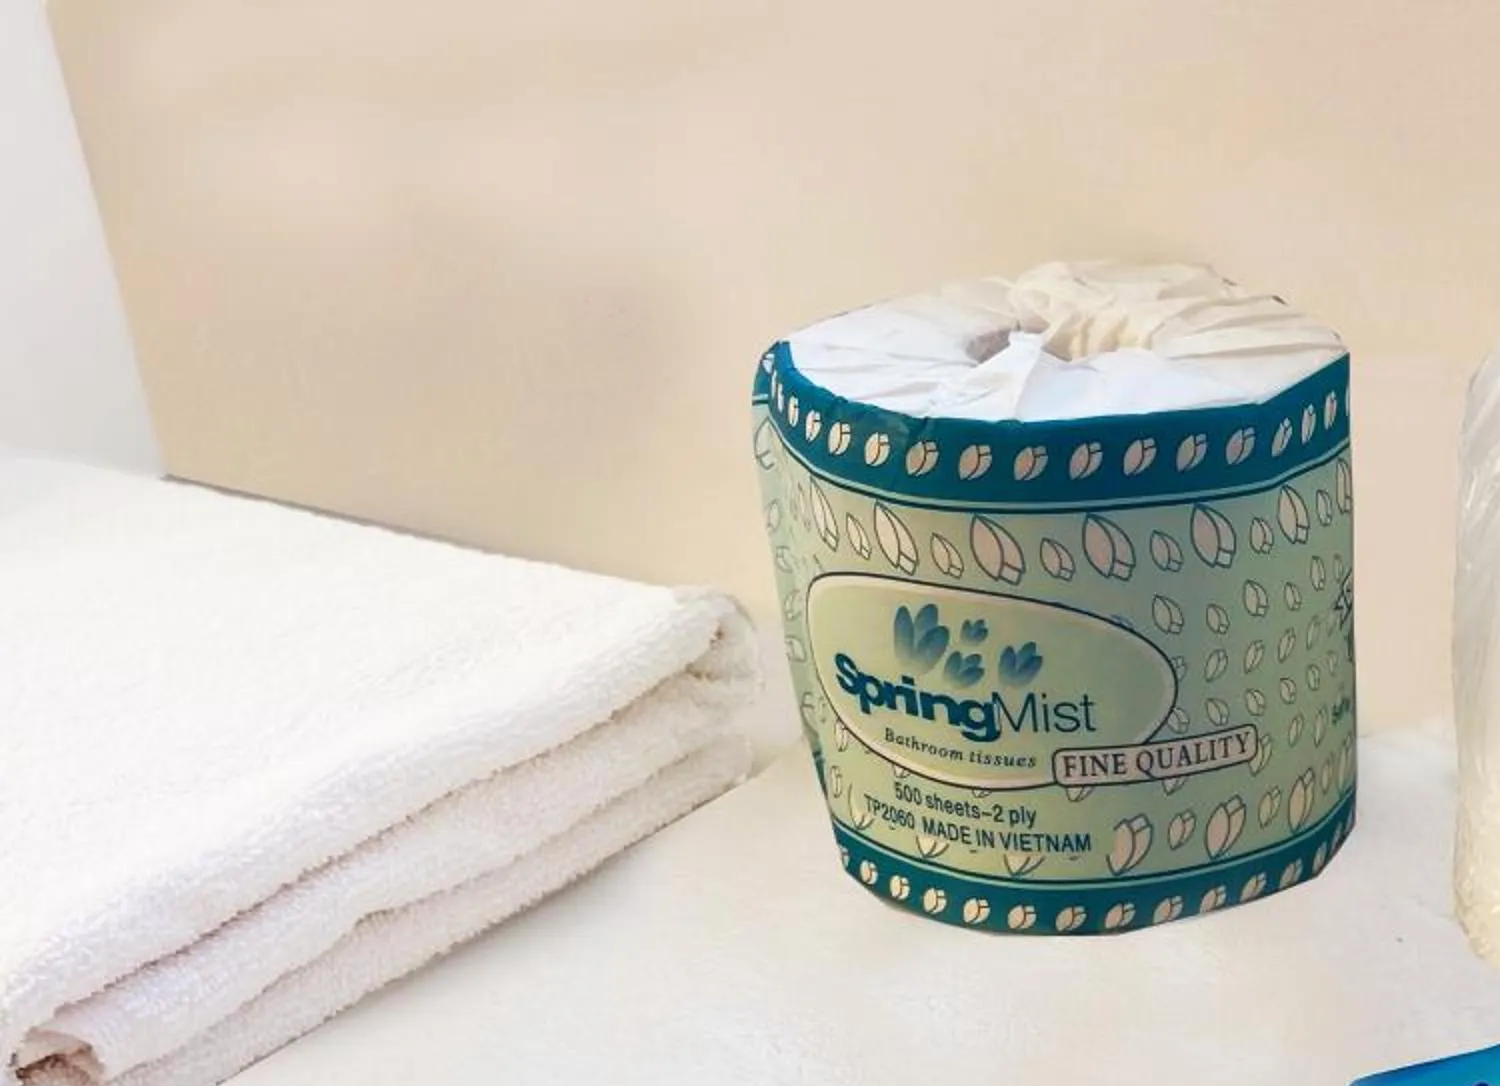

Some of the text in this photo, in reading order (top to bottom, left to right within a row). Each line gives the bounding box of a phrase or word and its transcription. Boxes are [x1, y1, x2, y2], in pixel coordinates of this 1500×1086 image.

[885, 727, 1037, 768] Bathroom tissues
[1063, 731, 1250, 780] FINE QUALITY
[864, 793, 1092, 852] TP2060 MADE IN VIETNAM
[894, 781, 923, 805] 500
[1009, 808, 1037, 829] ply
